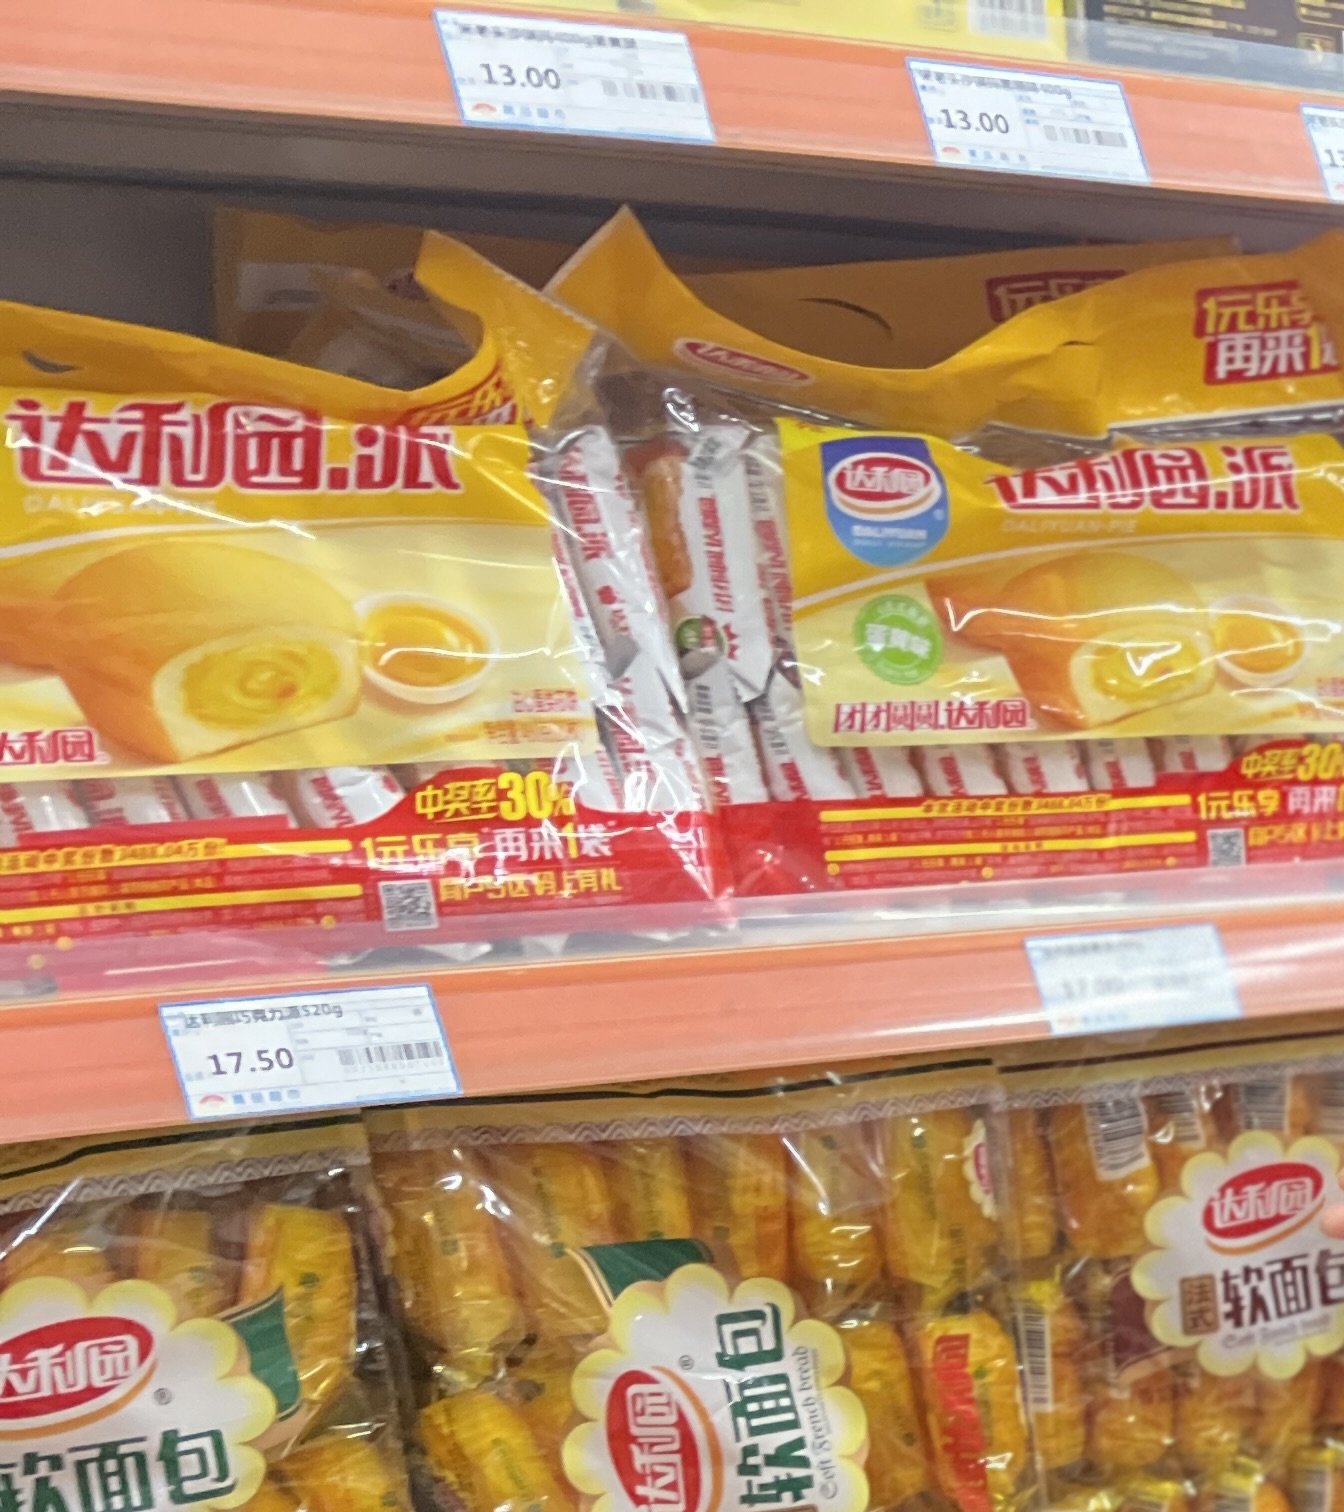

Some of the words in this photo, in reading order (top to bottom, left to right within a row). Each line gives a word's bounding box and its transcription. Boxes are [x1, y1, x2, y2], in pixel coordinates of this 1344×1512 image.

[480, 63, 561, 90] 13.00
[940, 108, 1009, 134] 13.00
[207, 1047, 294, 1076] 17.50
[1210, 1176, 1313, 1230] 达利园
[714, 1302, 815, 1507] 软面包
